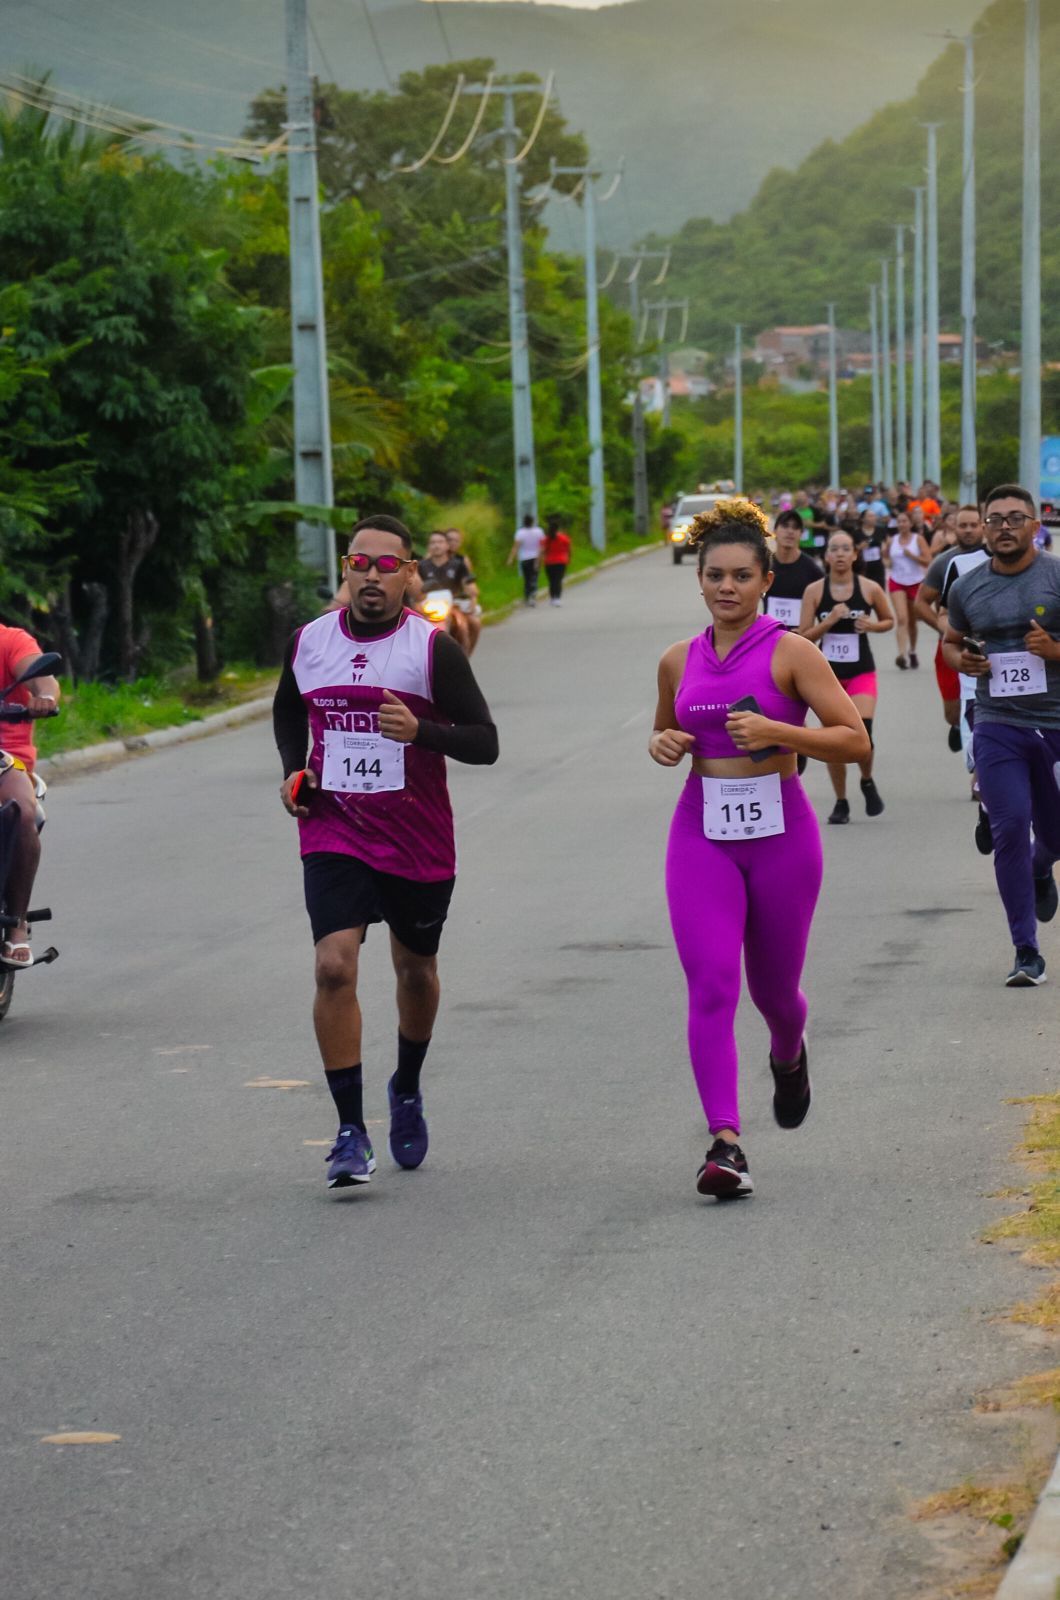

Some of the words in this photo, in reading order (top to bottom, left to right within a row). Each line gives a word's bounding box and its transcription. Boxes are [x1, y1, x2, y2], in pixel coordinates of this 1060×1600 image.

[831, 645, 850, 655] 110
[1001, 668, 1031, 683] 128
[342, 757, 383, 778] 144
[721, 801, 763, 823] 115
